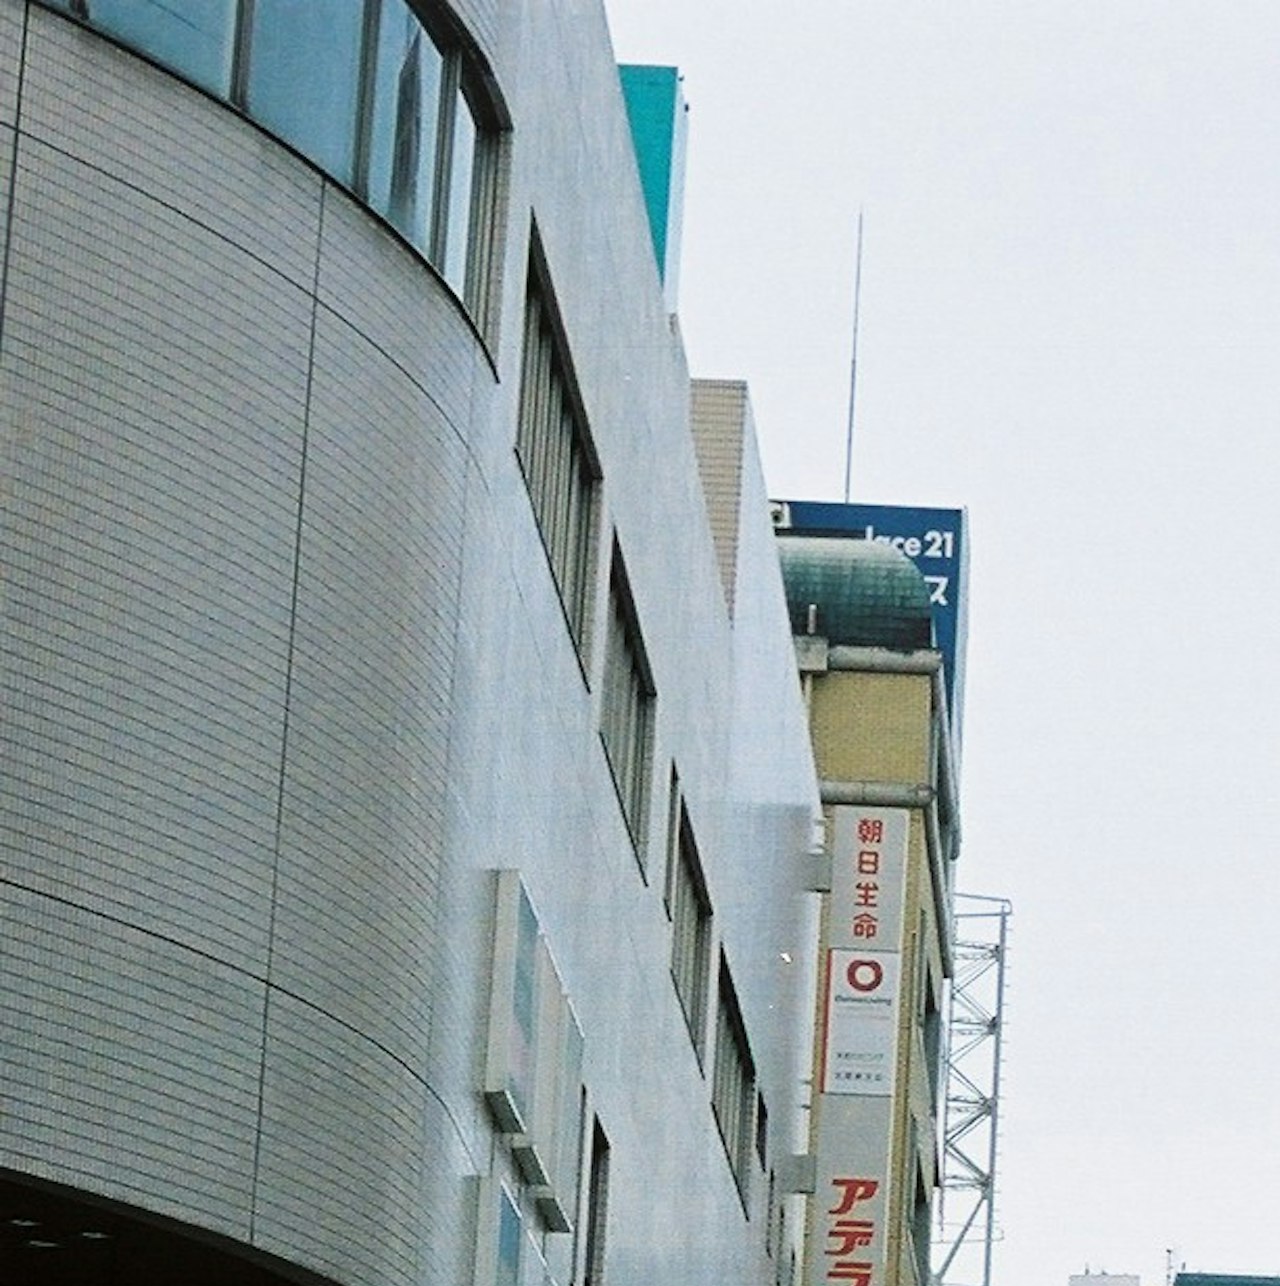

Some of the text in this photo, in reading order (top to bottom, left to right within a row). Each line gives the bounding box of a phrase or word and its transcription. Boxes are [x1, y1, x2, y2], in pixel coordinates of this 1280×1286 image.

[923, 530, 954, 559] 21
[854, 817, 884, 941] 朝日生命
